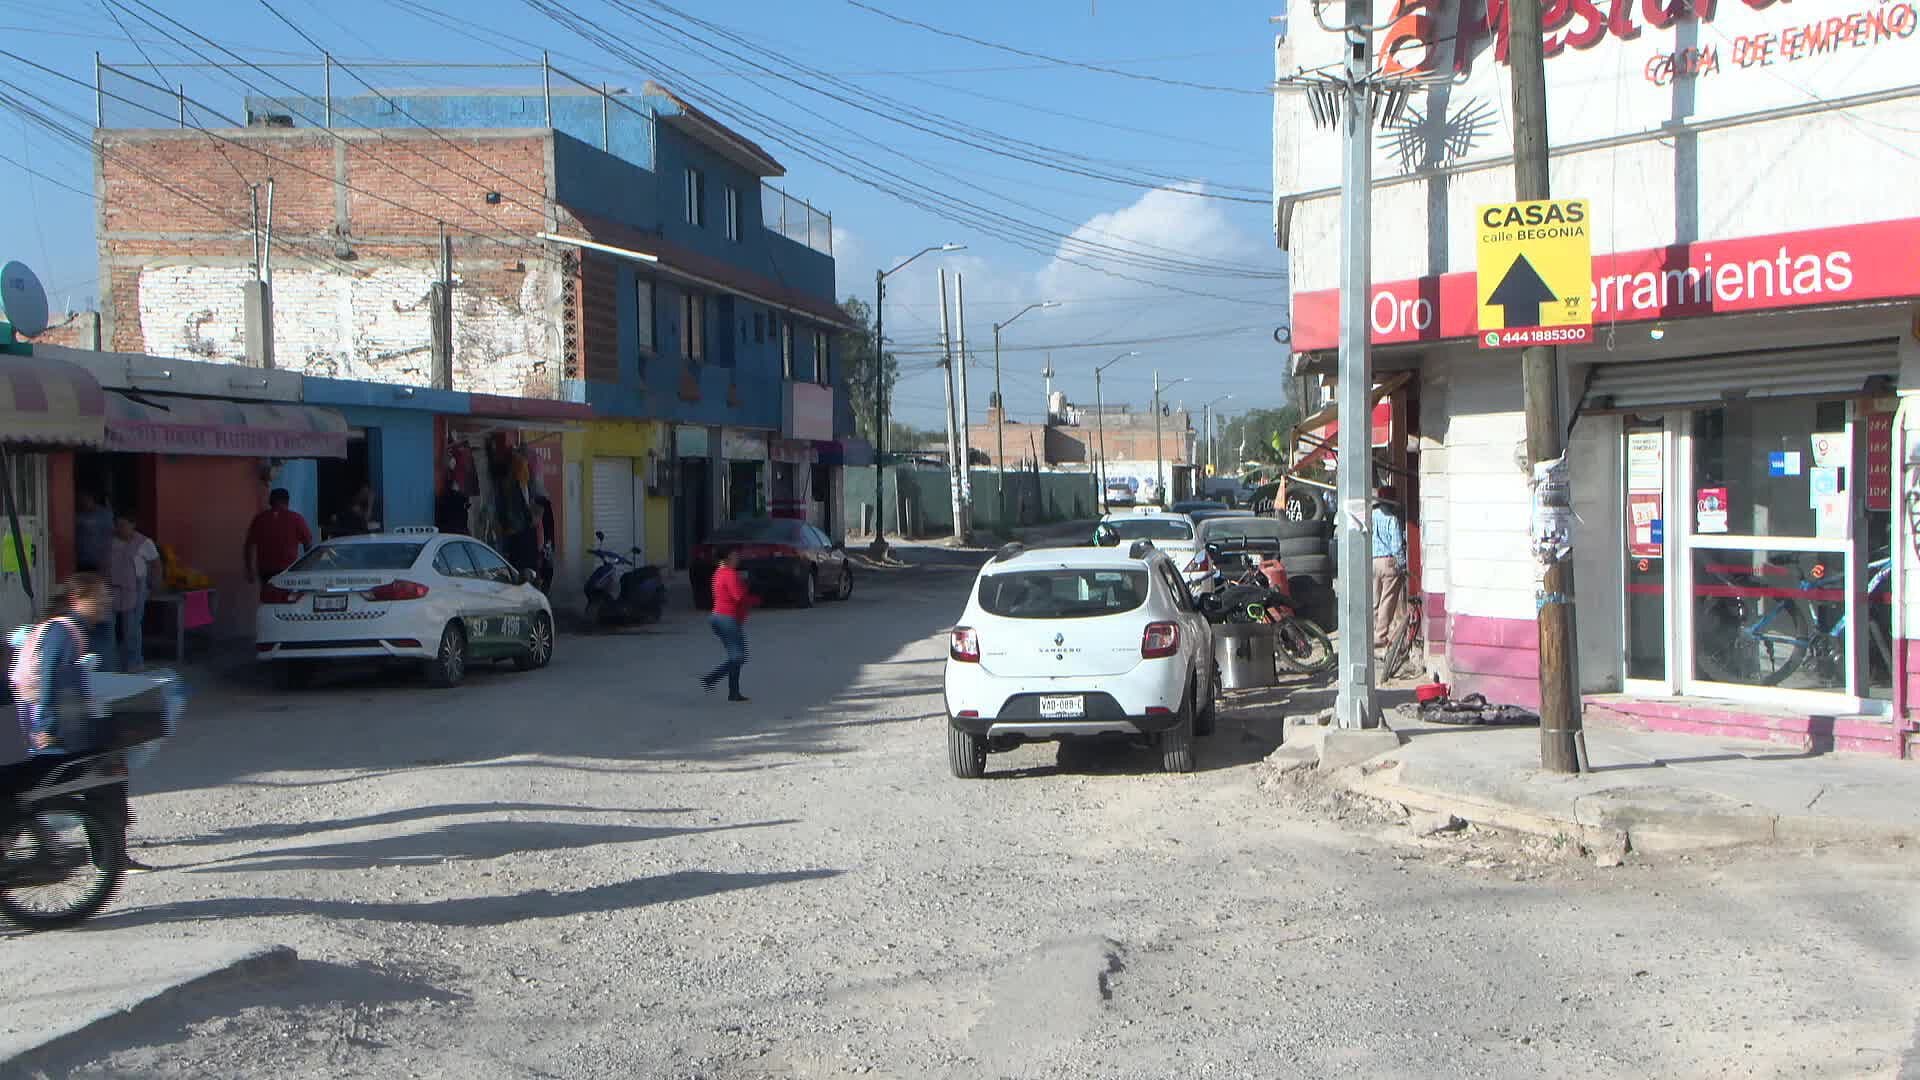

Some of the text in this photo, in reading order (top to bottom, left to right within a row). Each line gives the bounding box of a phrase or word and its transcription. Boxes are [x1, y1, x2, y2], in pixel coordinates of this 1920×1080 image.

[1731, 32, 1776, 67] DE
[1483, 202, 1585, 228] CASAS
[1483, 226, 1585, 242] calle BEGONIA
[1370, 290, 1432, 335] Oro
[1503, 328, 1585, 343] 444 1885300
